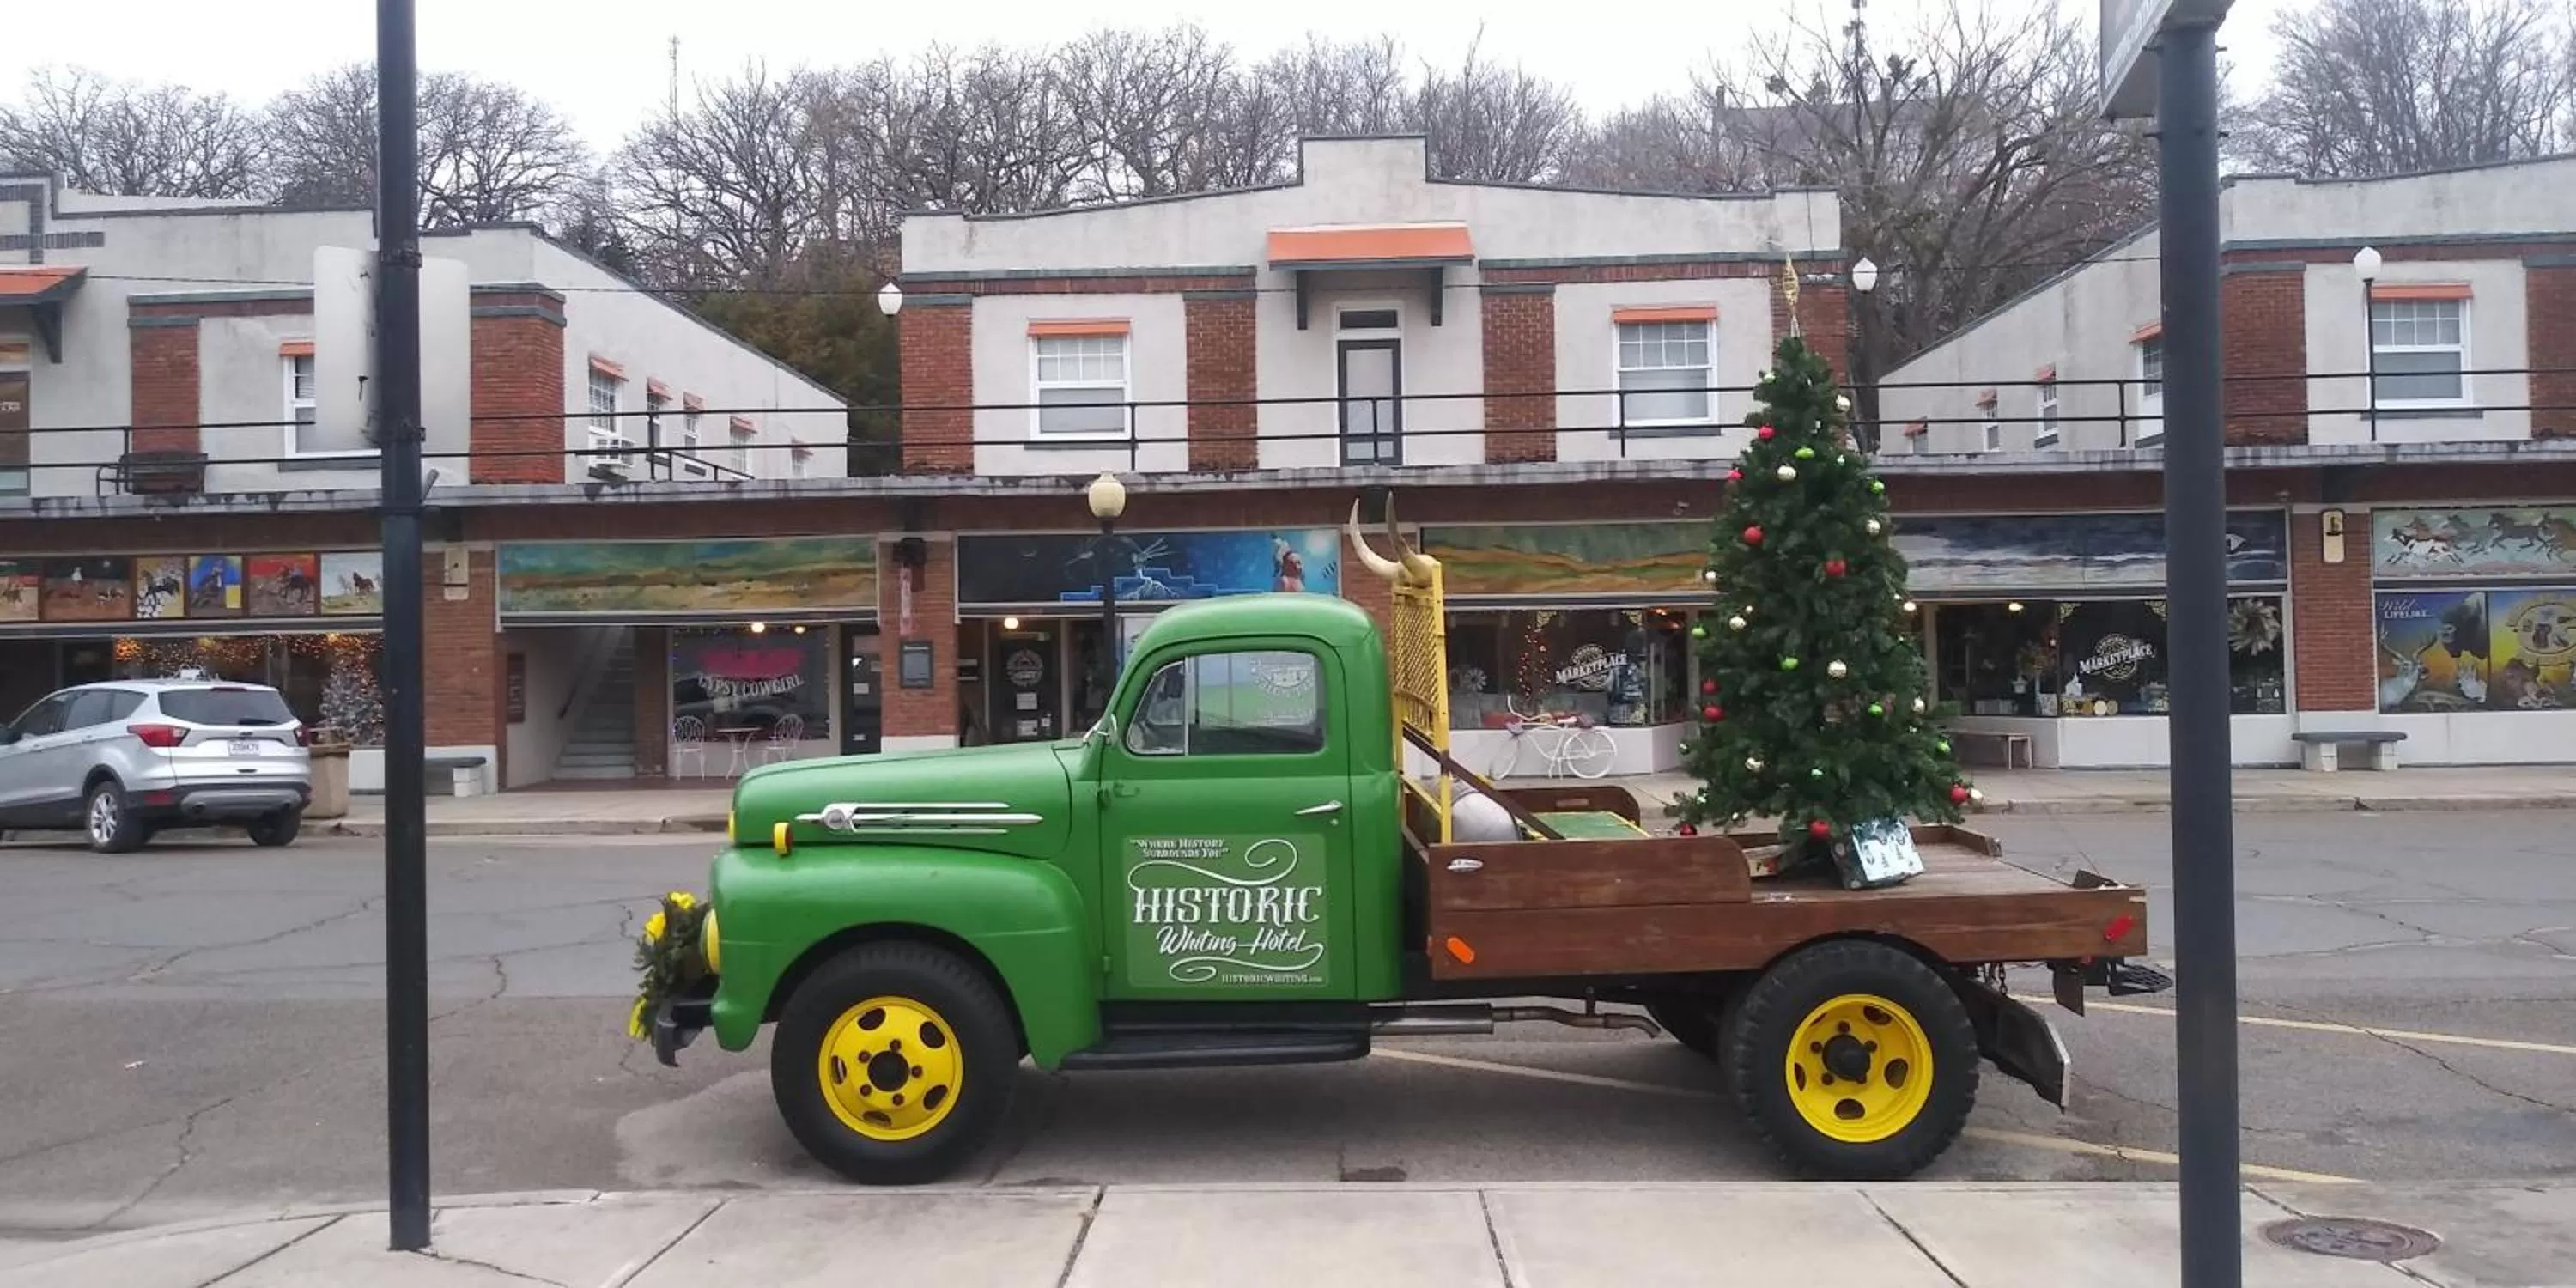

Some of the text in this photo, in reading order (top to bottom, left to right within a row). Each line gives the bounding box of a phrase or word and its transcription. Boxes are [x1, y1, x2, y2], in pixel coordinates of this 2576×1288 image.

[1555, 653, 1627, 684] MARKETPLACE
[2078, 643, 2153, 674] MARKETPLACE
[742, 674, 804, 697] COWGIRL
[1132, 885, 1323, 927] HISTORIC
[1156, 925, 1307, 956] Whiting Hotel
